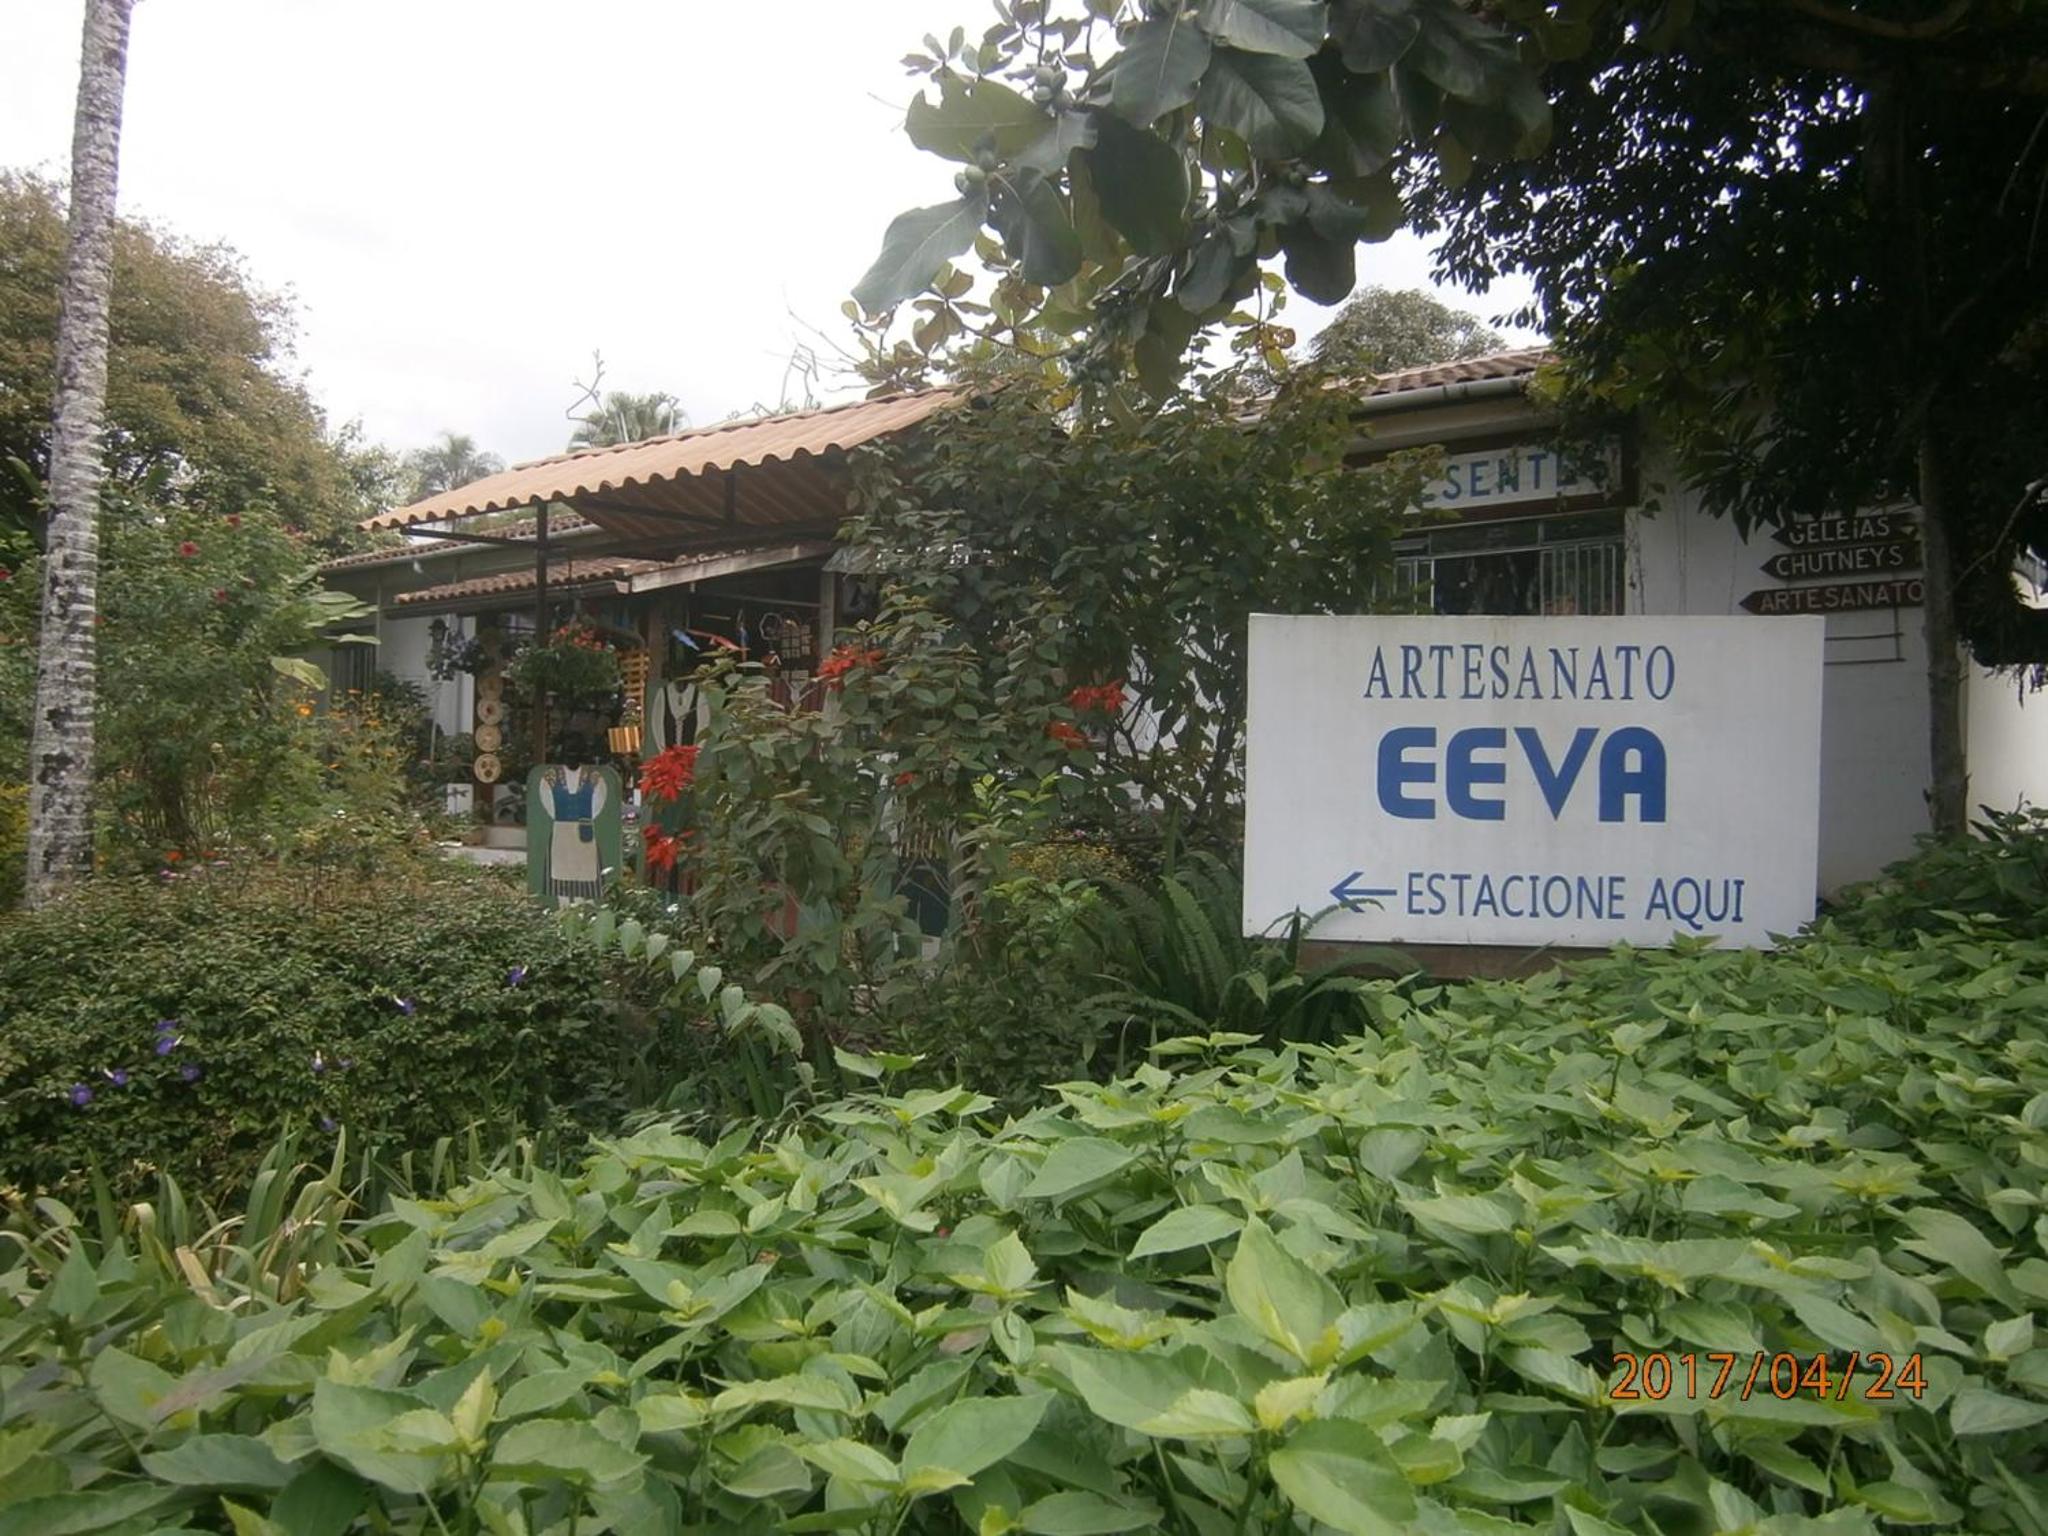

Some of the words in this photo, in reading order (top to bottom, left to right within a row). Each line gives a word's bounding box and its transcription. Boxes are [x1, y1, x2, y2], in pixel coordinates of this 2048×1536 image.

[1775, 545, 1904, 577] CHUTNEYS
[1759, 580, 1925, 613] ARTESANATO
[1363, 643, 1676, 701] ARTESANATO
[1376, 726, 1667, 823] EEVA
[1406, 871, 1626, 920] ESTACIONE
[1645, 876, 1745, 930] AQUI
